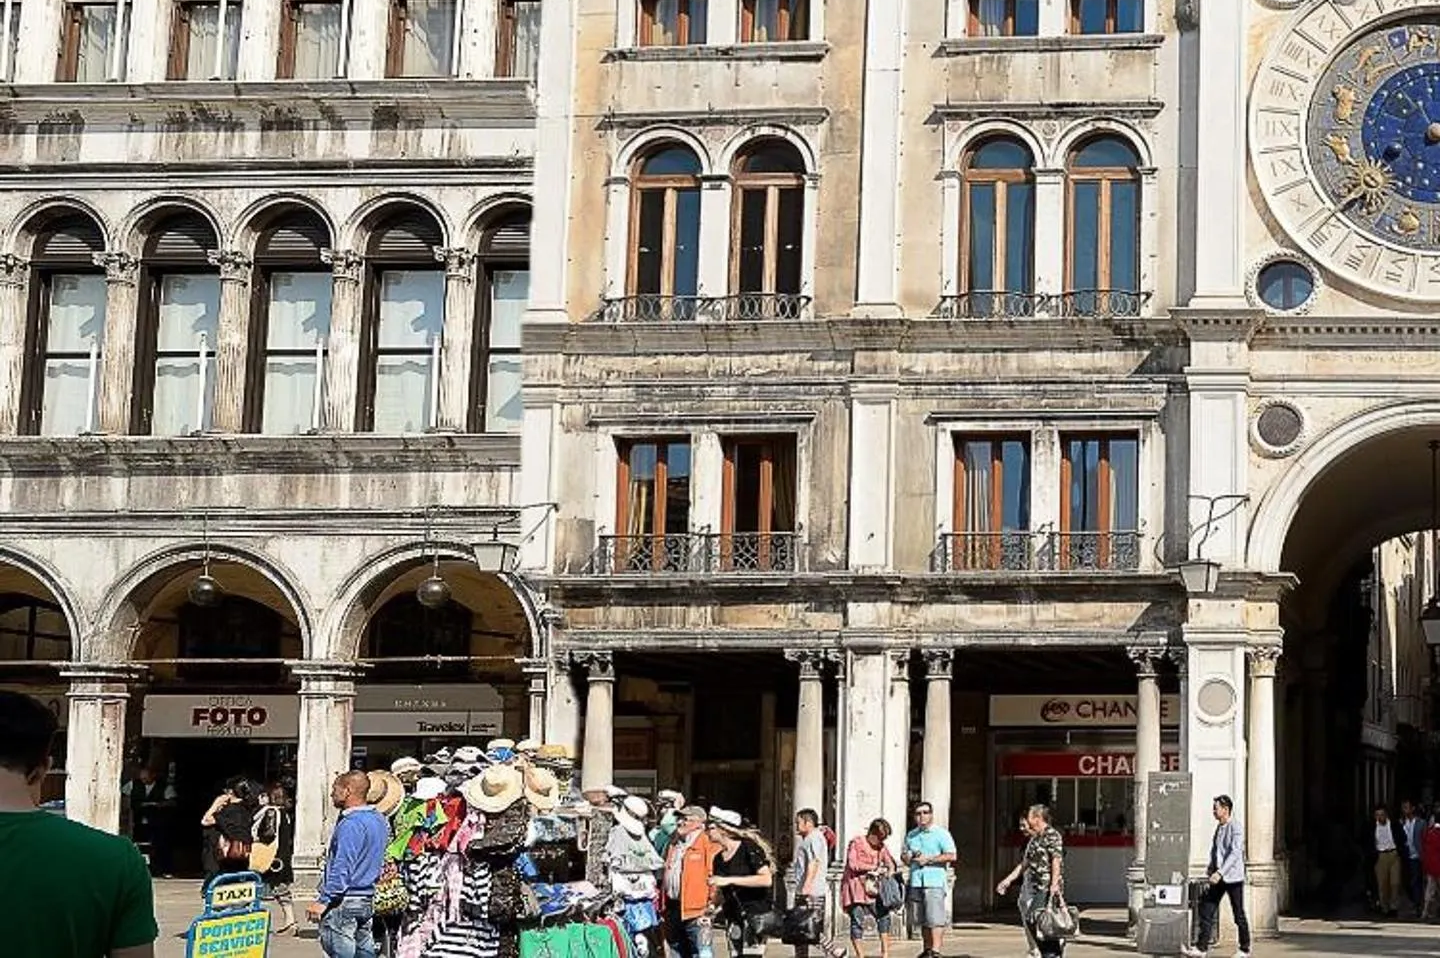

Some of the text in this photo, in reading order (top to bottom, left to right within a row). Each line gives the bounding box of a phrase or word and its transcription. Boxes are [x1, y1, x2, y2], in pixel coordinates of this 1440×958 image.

[192, 707, 267, 726] FOTO
[1076, 700, 1169, 718] CHANE
[216, 888, 252, 901] TAXI
[202, 918, 265, 938] PORTER
[200, 933, 264, 954] SERVICE
